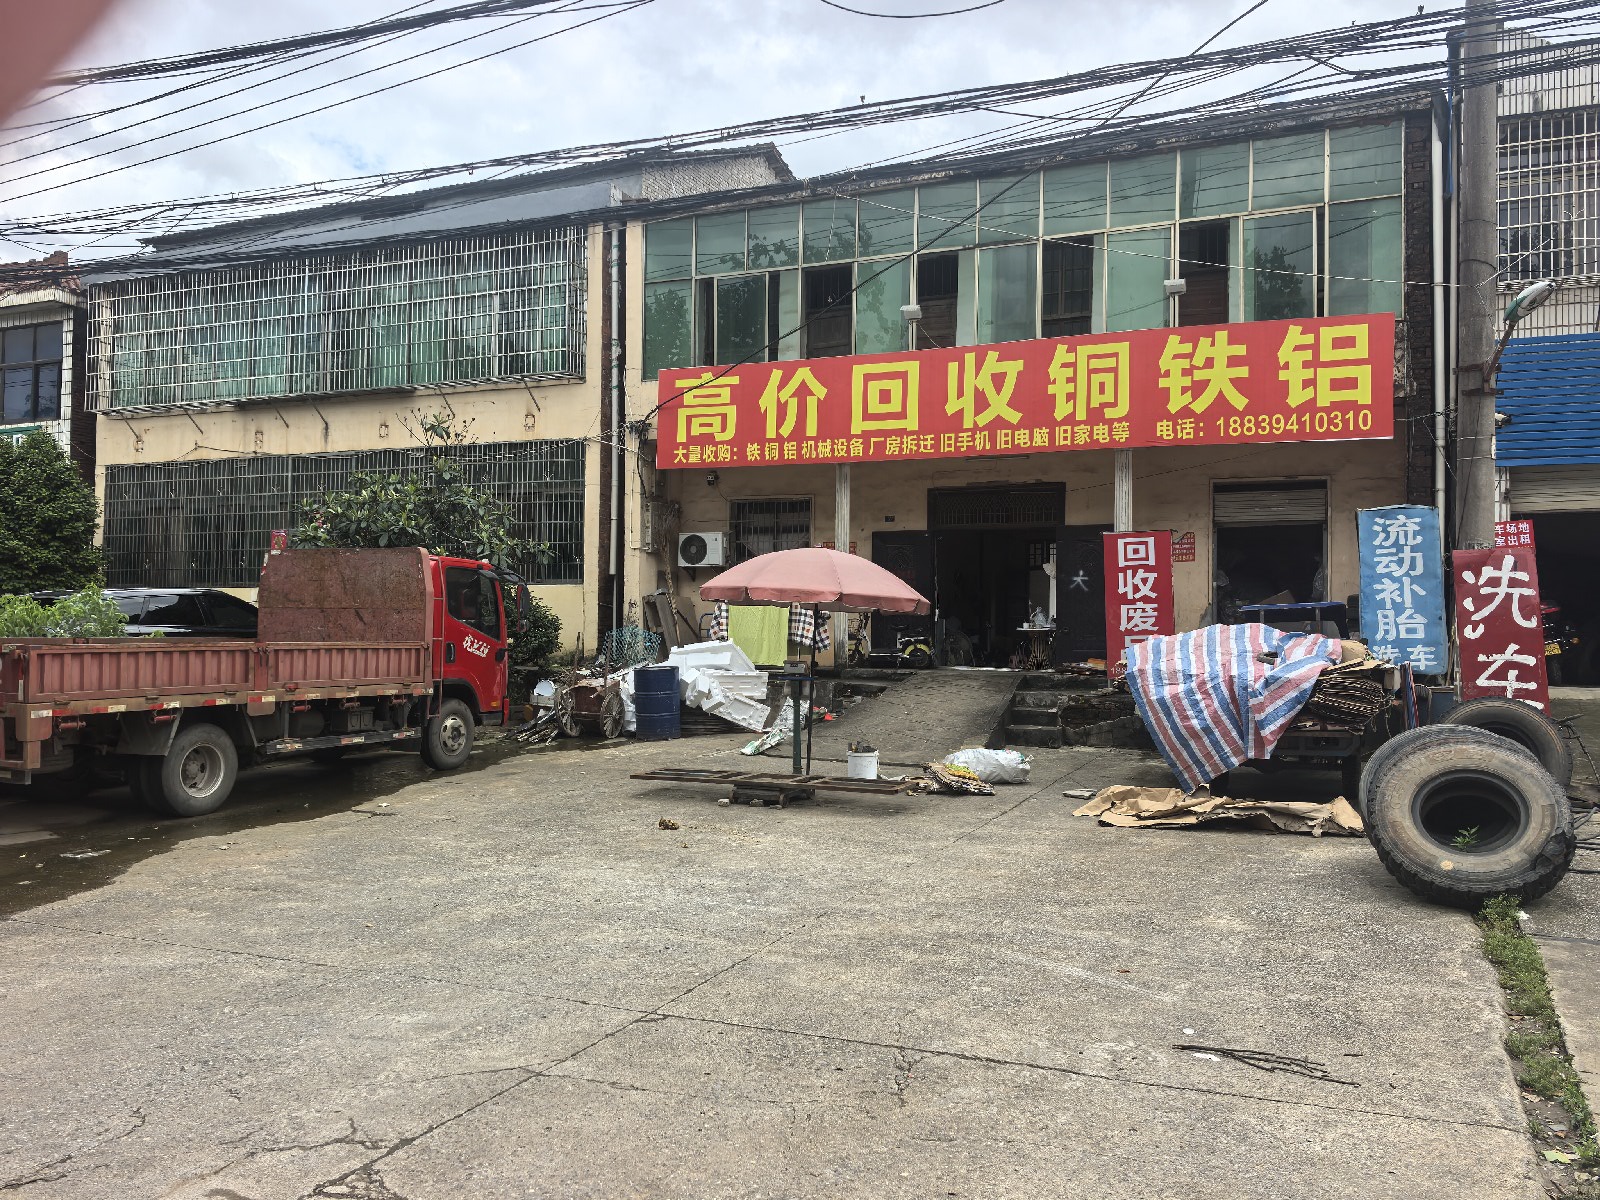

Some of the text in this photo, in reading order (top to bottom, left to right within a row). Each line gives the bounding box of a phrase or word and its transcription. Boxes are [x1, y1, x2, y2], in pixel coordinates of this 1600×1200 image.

[801, 438, 864, 460] 机械设备
[868, 434, 935, 456] 厂房拆迁
[940, 431, 991, 453] 旧手机
[997, 427, 1049, 450] 旧电脑
[1055, 421, 1130, 447] 旧家电等
[1372, 514, 1428, 642] 流动补胎
